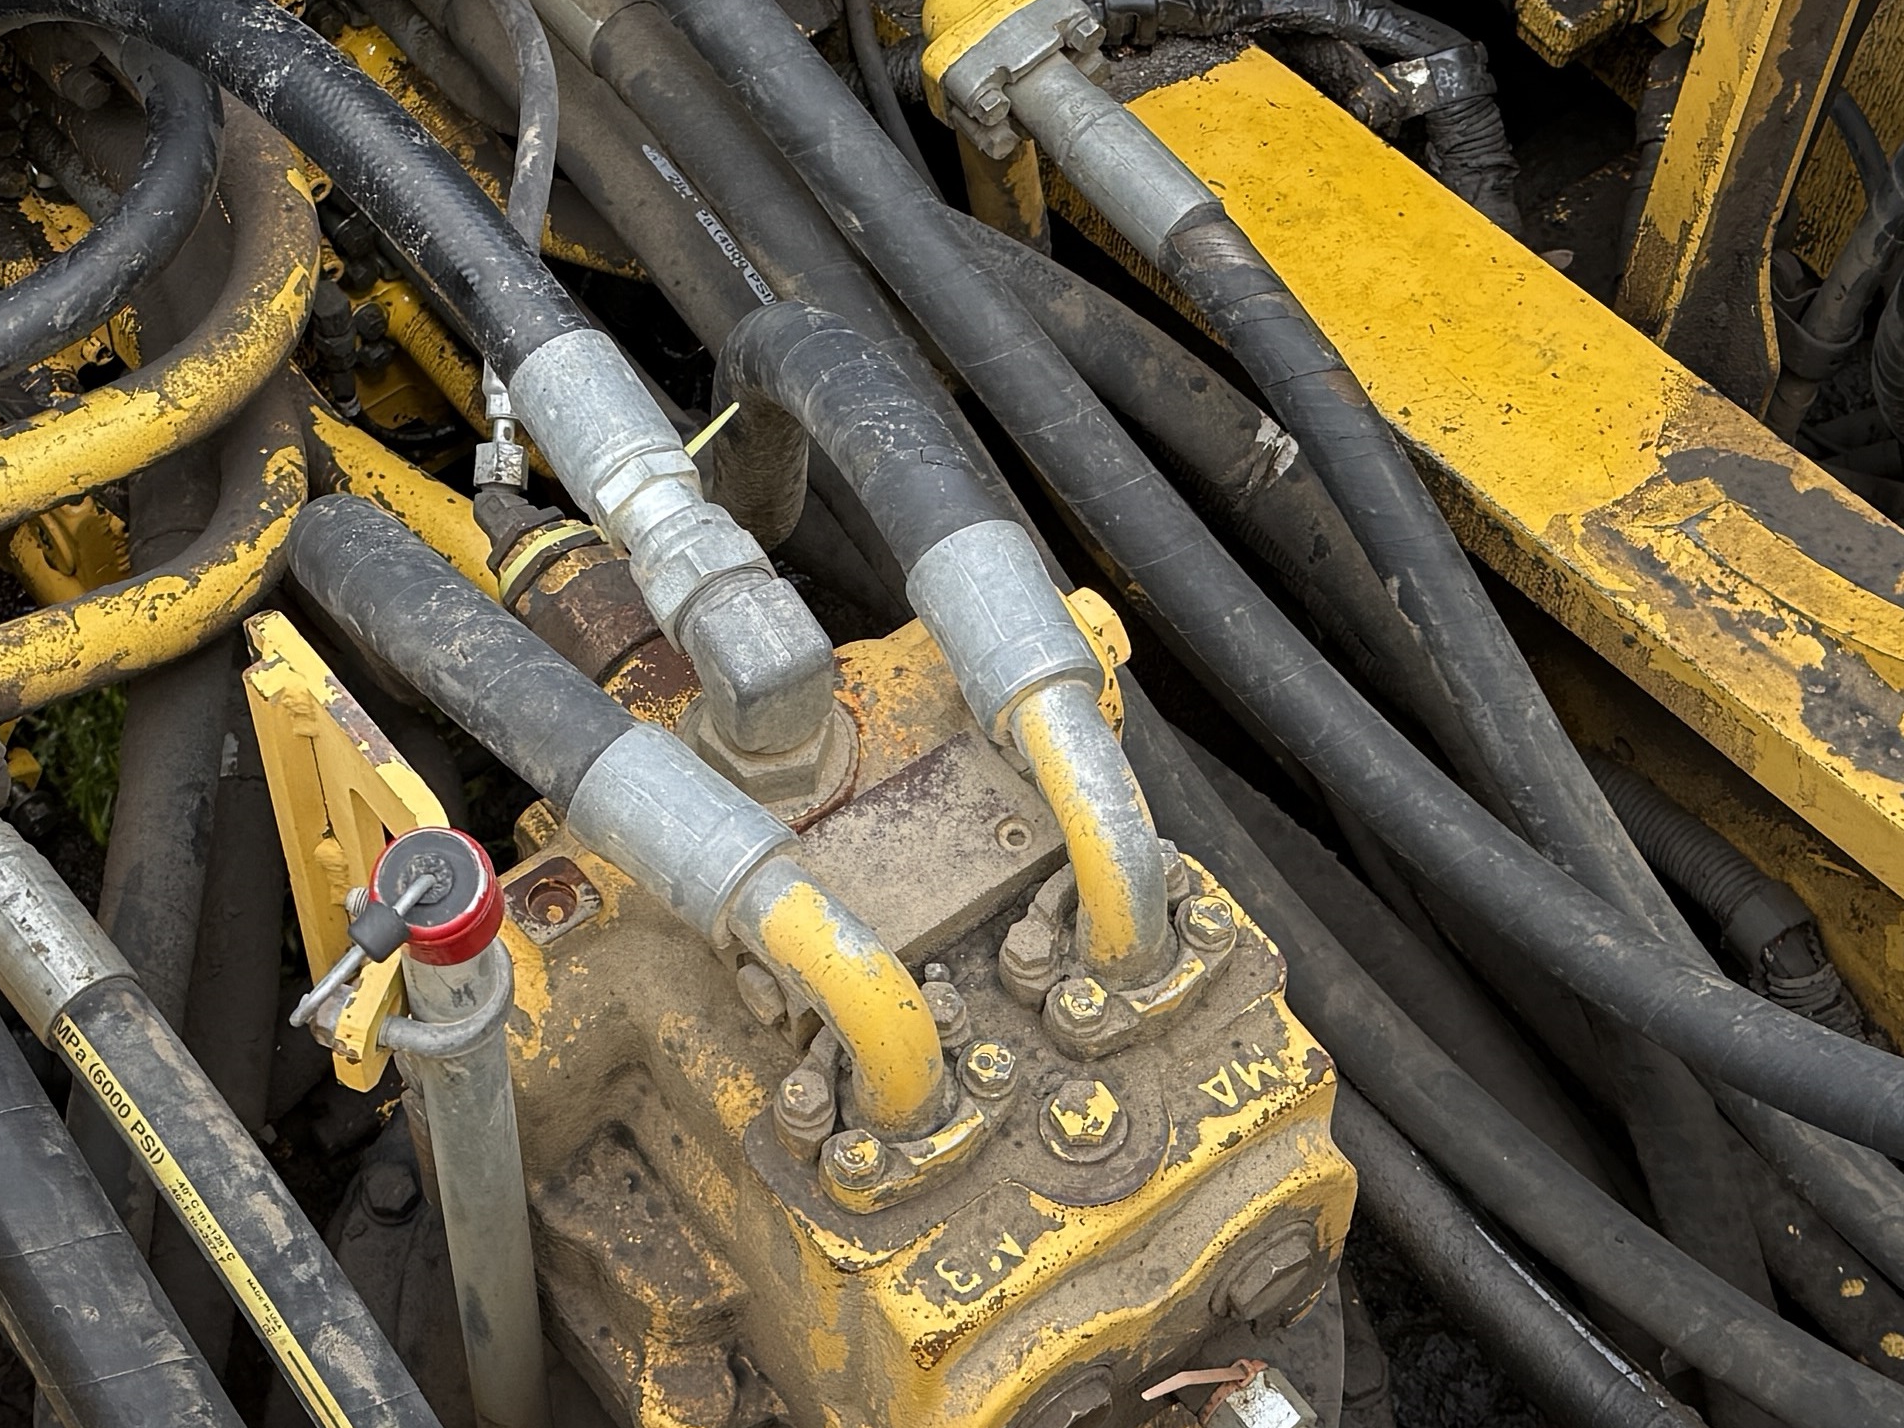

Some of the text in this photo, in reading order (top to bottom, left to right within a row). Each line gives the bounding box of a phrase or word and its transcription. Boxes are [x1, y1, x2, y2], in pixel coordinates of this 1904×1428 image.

[710, 227, 750, 273] (4000
[745, 270, 776, 307] PSI)
[48, 1015, 167, 1168] MPa (6000 PSI)
[244, 1277, 265, 1303] MADE
[267, 1312, 283, 1331] USA
